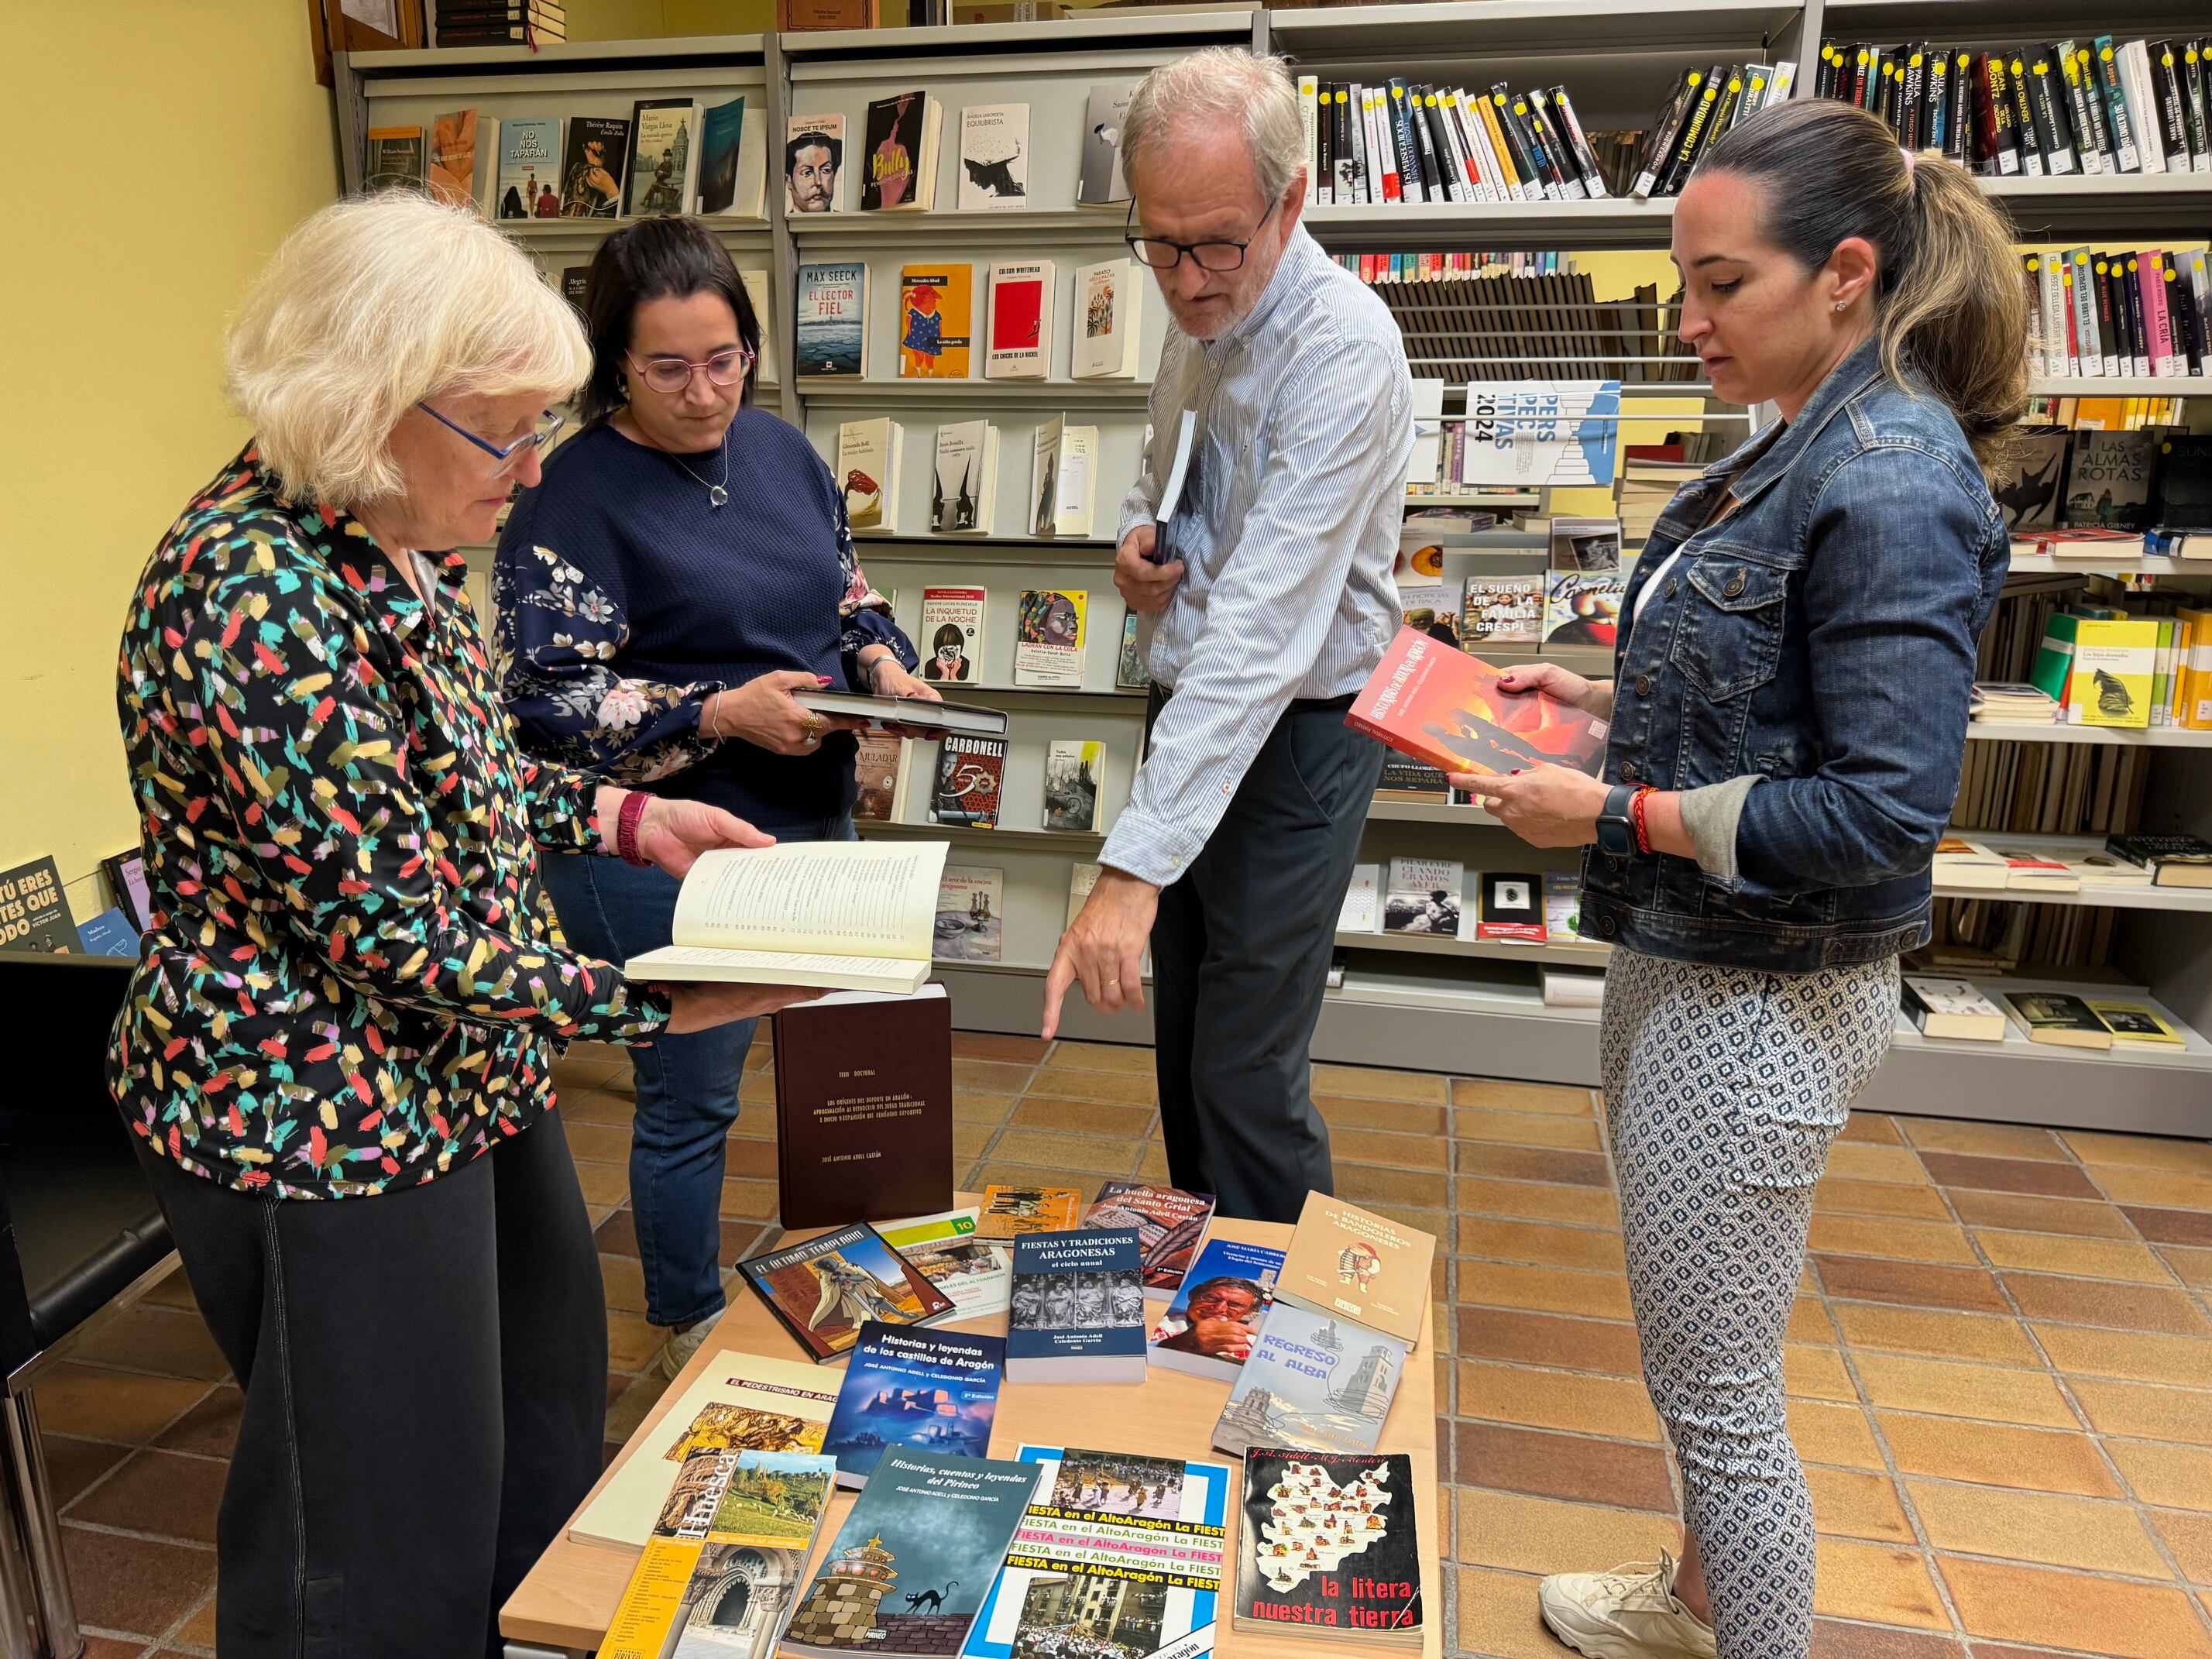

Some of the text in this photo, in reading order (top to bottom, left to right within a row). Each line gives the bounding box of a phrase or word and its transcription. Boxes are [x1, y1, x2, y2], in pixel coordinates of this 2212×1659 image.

[1914, 70, 1922, 98] PAULA
[967, 118, 1004, 128] EQUILIBRISTA
[1678, 101, 1710, 161] LA COMUNIDAD
[520, 140, 538, 149] NOS
[522, 131, 535, 139] NO
[510, 148, 548, 158] TAPARÁN
[873, 148, 912, 181] Bully
[806, 270, 857, 283] MAX SEECK
[809, 290, 854, 301] EL LECTOR
[819, 301, 843, 315] FIEL
[1475, 393, 1496, 443] 2024
[2102, 441, 2125, 453] LAS
[2083, 453, 2142, 466] ALMAS
[2078, 468, 2142, 482] ROTAS
[1470, 584, 1486, 593] EL
[1473, 596, 1534, 606] DE LA
[936, 607, 977, 616] INQUIETUD
[1481, 609, 1536, 619] FAMILIA
[945, 736, 1003, 757] CARBONELL
[18, 868, 53, 895] ERES
[26, 886, 59, 911] QUE
[1125, 1188, 1154, 1198] huella
[1156, 1194, 1206, 1206] aragonesa
[1133, 1197, 1162, 1207] Santo
[1164, 1202, 1191, 1212] Grial
[1119, 1205, 1149, 1214] Antonio
[1172, 1213, 1198, 1221] Castán
[1342, 1210, 1396, 1235] HISTORIAS
[957, 1221, 973, 1230] 10
[1325, 1211, 1411, 1248] DE BANDOLEROS
[1332, 1221, 1400, 1249] ARAGONESES
[755, 1265, 764, 1274] EL
[770, 1252, 807, 1270] ÚLTIMO
[809, 1230, 864, 1256] TEMPLARIO
[1022, 1241, 1059, 1249] FIESTAS
[1069, 1237, 1133, 1248] TRADICIONES
[1039, 1248, 1116, 1259] ARAGONESAS
[881, 1334, 927, 1349] Historias
[938, 1343, 983, 1356] leyendas
[1263, 1334, 1336, 1365] REGRESO
[864, 1345, 994, 1371] de los castillos de Aragón
[1256, 1349, 1327, 1379] AL ALBA
[879, 1365, 906, 1373] ANTONIO
[931, 1372, 963, 1382] CELEDONIO
[741, 1380, 799, 1396] PEDESTRISMO
[801, 1389, 813, 1399] EN
[891, 1459, 936, 1475] Historias,
[939, 1468, 975, 1479] cuentos
[984, 1472, 1027, 1483] leyendas
[943, 1479, 980, 1490] Pirineo
[1064, 1510, 1079, 1519] en
[1084, 1512, 1095, 1521] el
[1099, 1513, 1171, 1531] AltoAragón
[1176, 1523, 1190, 1533] La
[1194, 1525, 1225, 1537] FIEST
[1062, 1523, 1077, 1532] en
[1081, 1524, 1092, 1534] el
[1096, 1527, 1170, 1544] AltoAragón
[1174, 1534, 1188, 1545] La
[1193, 1537, 1224, 1549] FIEST
[1016, 1531, 1223, 1562] FIESTA en el AltoAragón La FIEST
[1012, 1543, 1221, 1576] FIESTA en el AltoAragón La FIEST
[1007, 1555, 1220, 1590] FIESTA en el AltoAragón La FIEST
[1322, 1575, 1411, 1599] la litera
[1253, 1601, 1413, 1627] nuestra tierra
